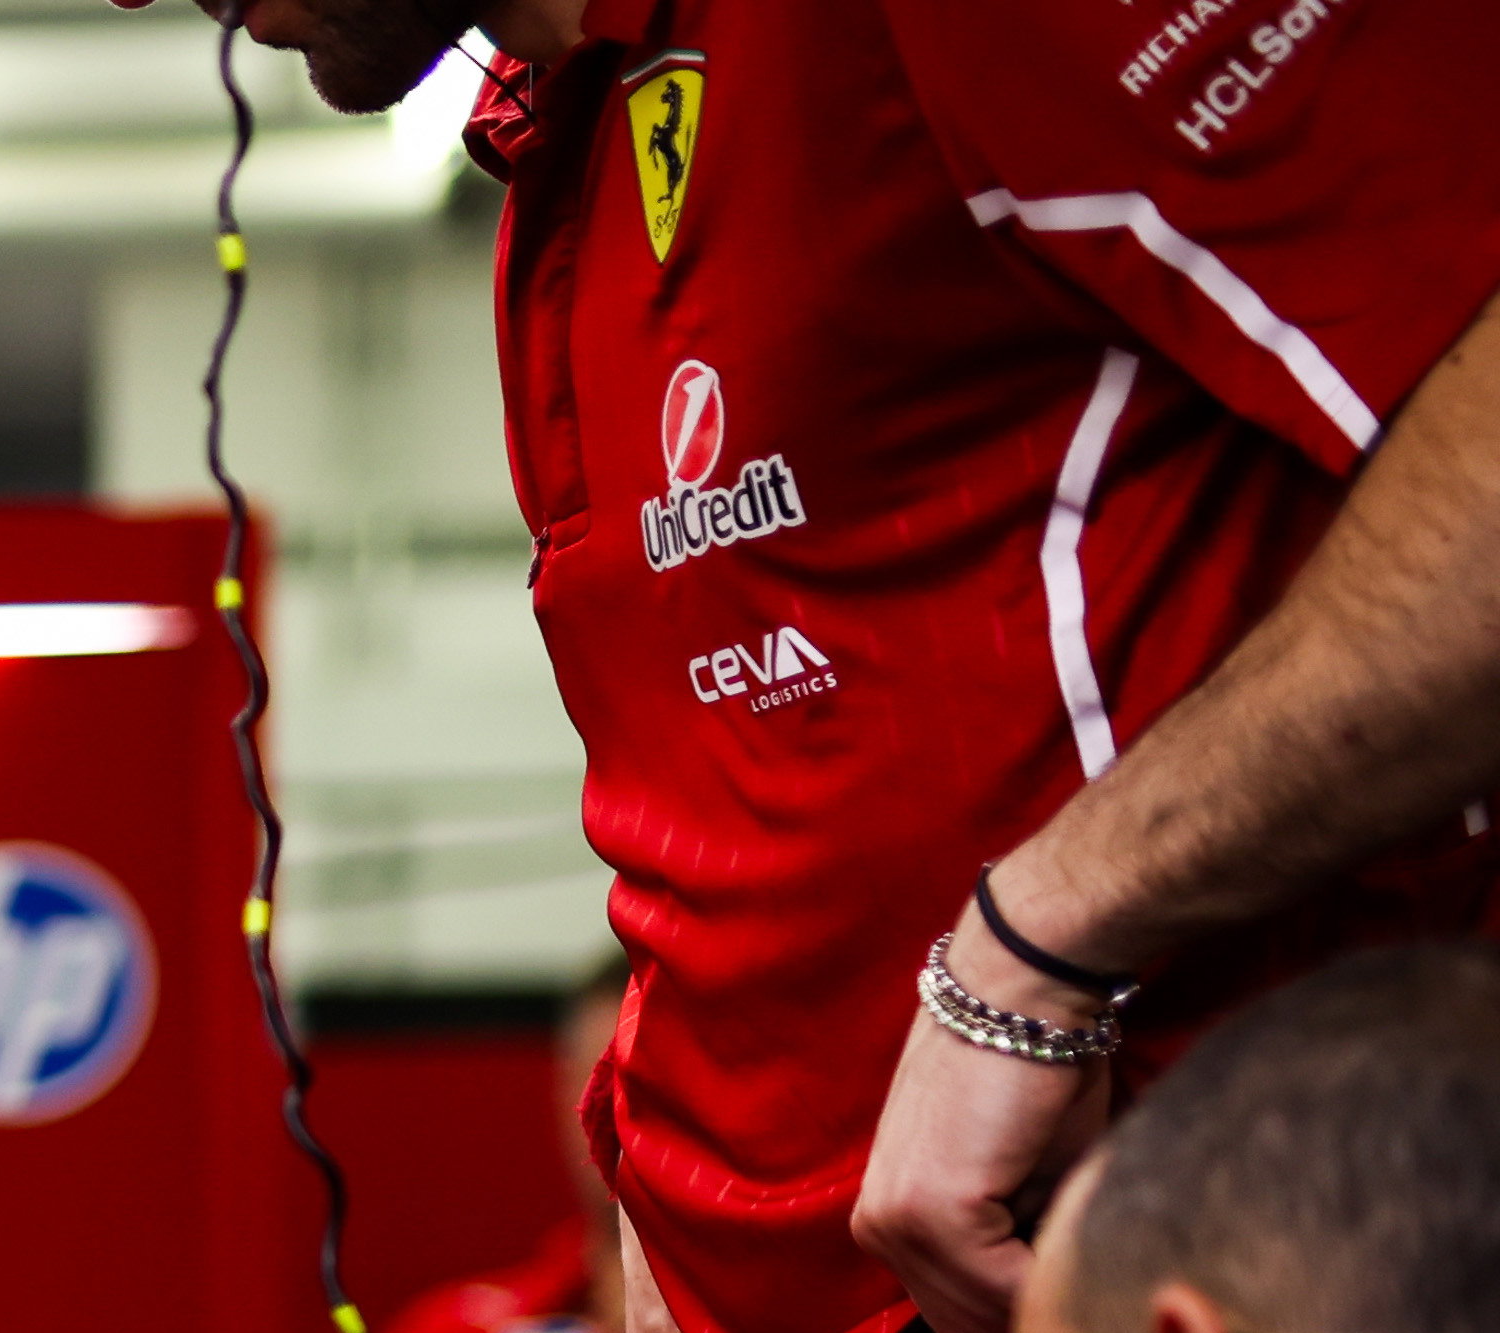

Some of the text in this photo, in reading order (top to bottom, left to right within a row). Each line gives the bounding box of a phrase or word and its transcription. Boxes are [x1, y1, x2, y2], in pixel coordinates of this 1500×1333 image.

[1118, 0, 1236, 95] RICHA
[643, 461, 799, 566] UniCredit
[750, 672, 838, 714] LOGISTICS
